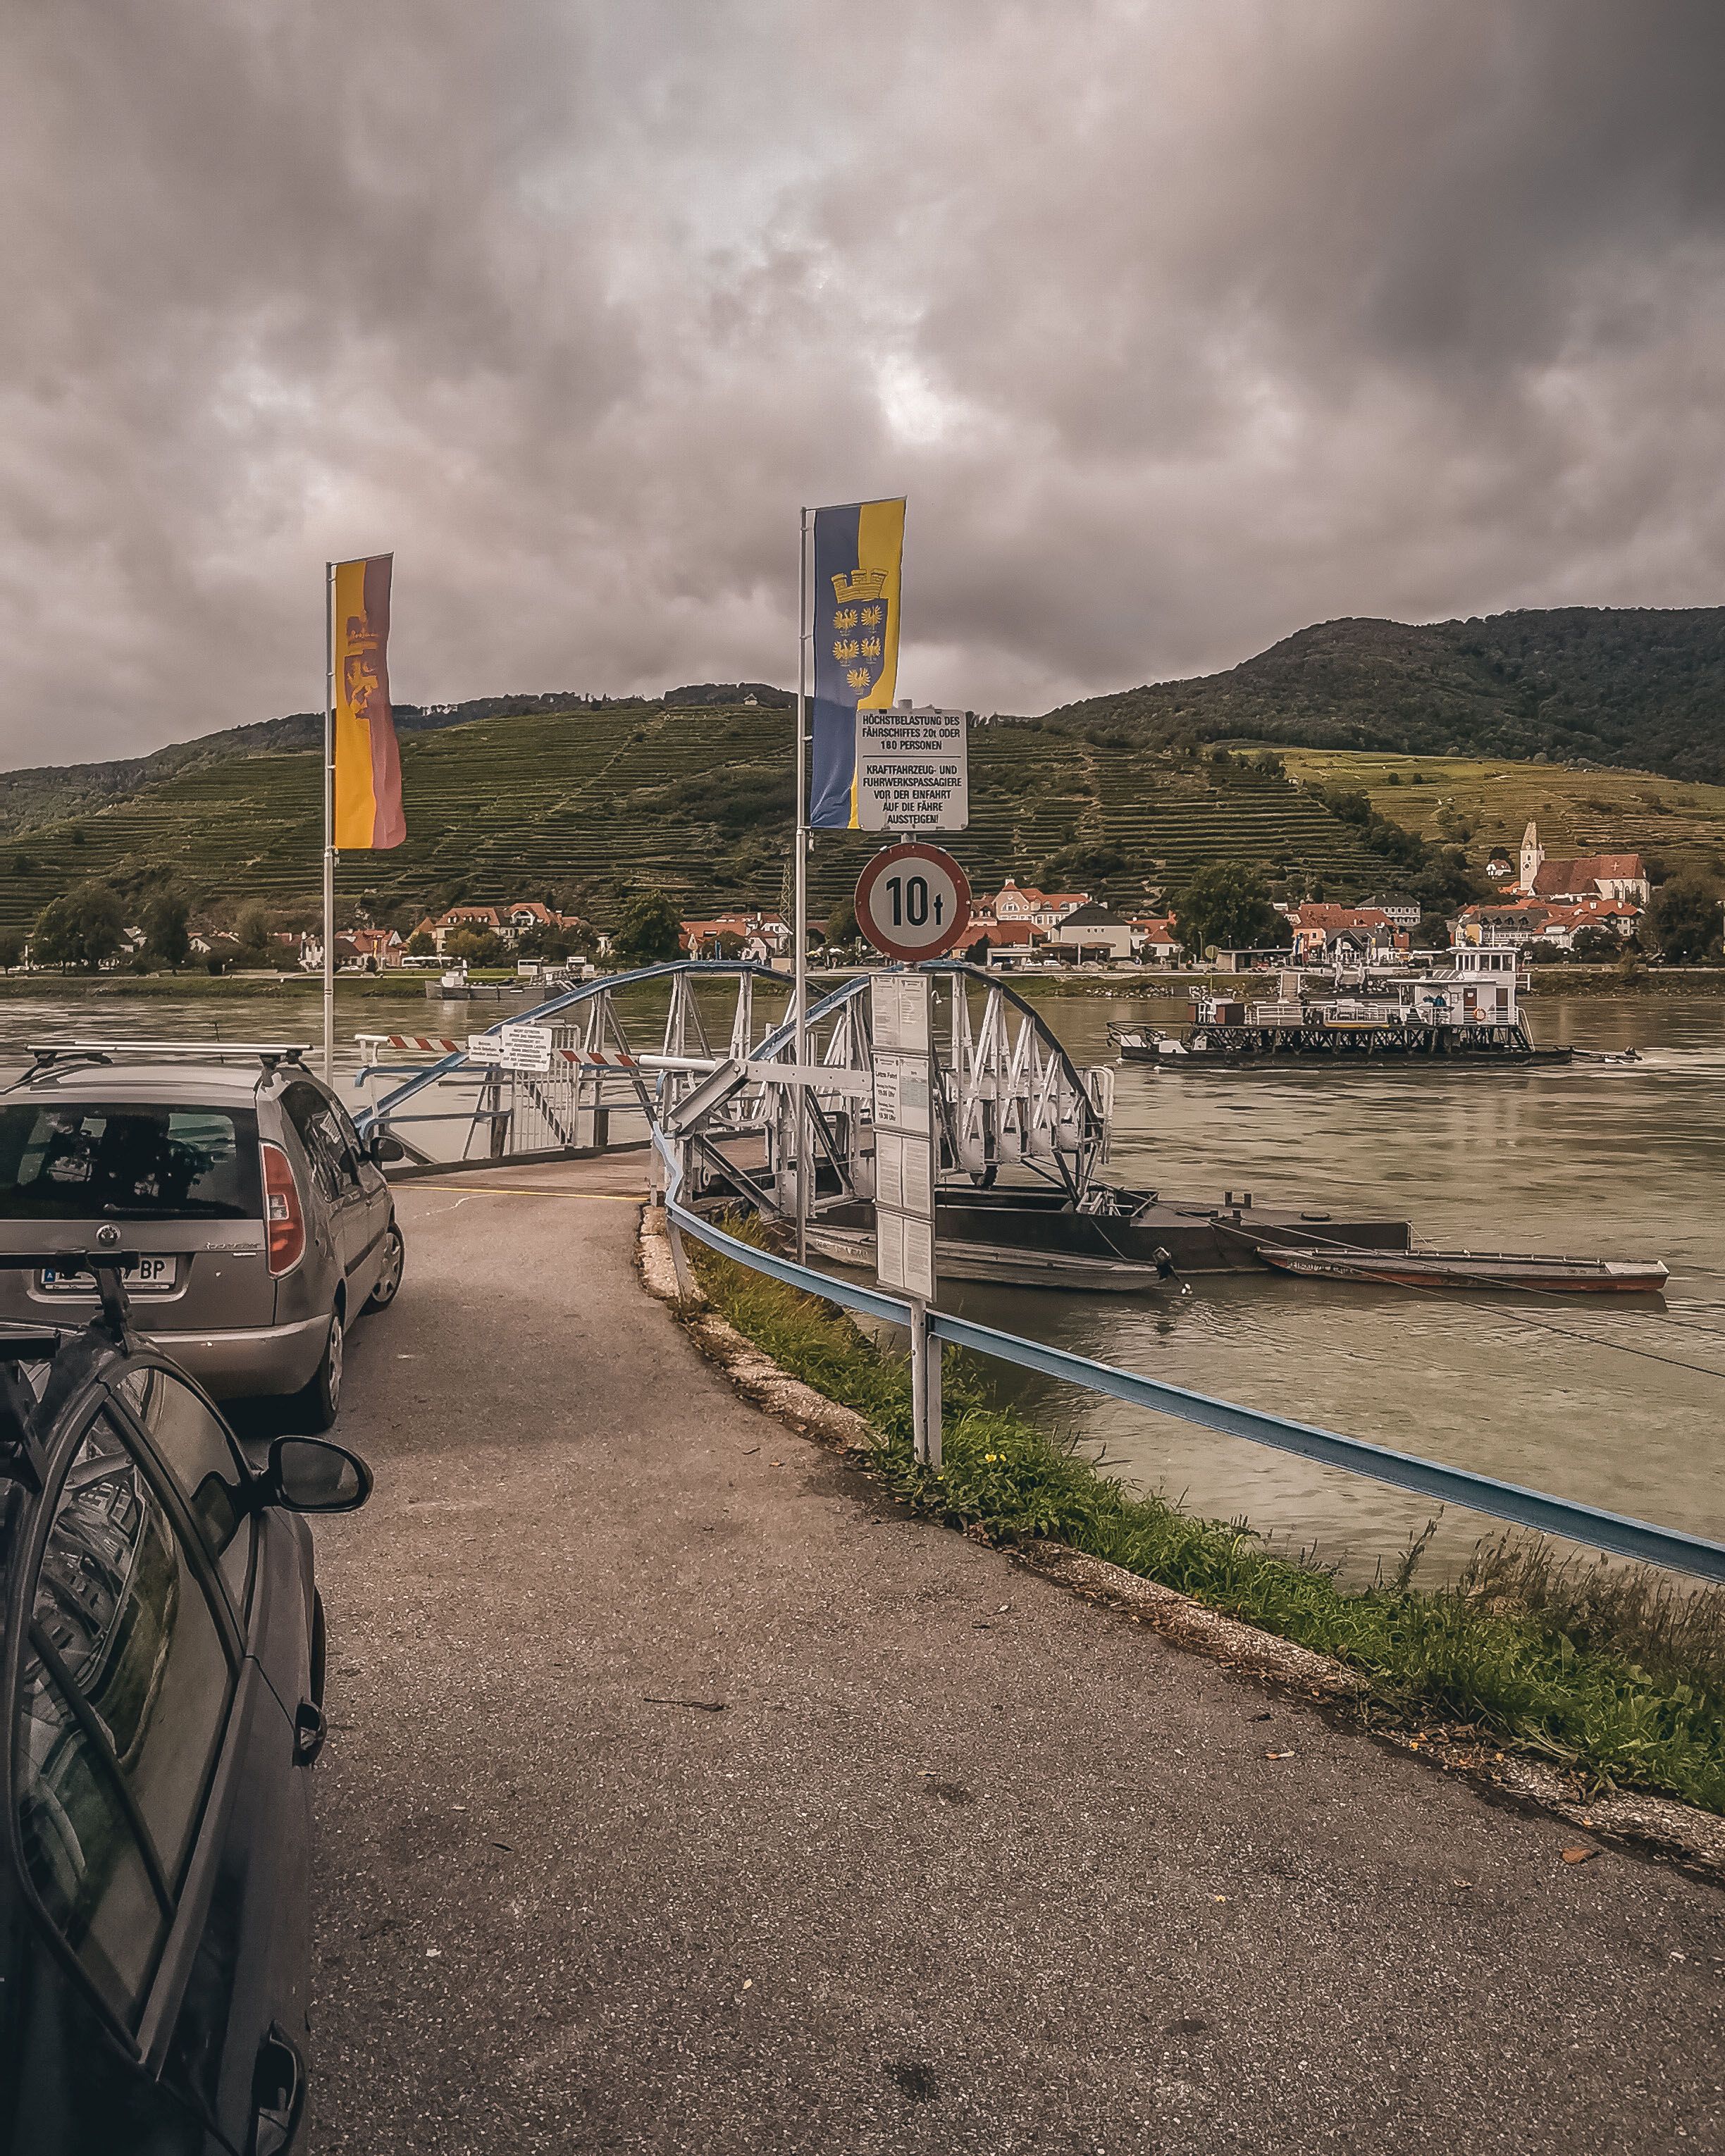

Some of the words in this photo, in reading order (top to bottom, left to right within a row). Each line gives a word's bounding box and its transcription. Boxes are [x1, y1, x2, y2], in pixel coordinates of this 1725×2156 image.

[863, 714, 941, 726] HÖCHSTBELASTUNG
[944, 716, 960, 726] DES
[862, 726, 920, 738] FÄHRSCHIFFES
[922, 729, 936, 738] 20t
[939, 729, 960, 738] ODER
[881, 741, 897, 750] 180
[900, 741, 942, 750] PERSONEN
[866, 765, 936, 775] KRAFTFAHRZEUG-
[939, 765, 958, 774] UND
[863, 777, 962, 787] FUHRWERKSPASSAGIERE
[874, 790, 891, 799] VOR
[894, 790, 910, 800] DER
[913, 790, 951, 800] EINFAHRT
[882, 802, 900, 812] AUF
[901, 802, 915, 812] DIE
[917, 800, 944, 812] FÄHRE
[887, 814, 939, 824] AUSSTEIGEN!
[140, 1260, 165, 1280] BP
